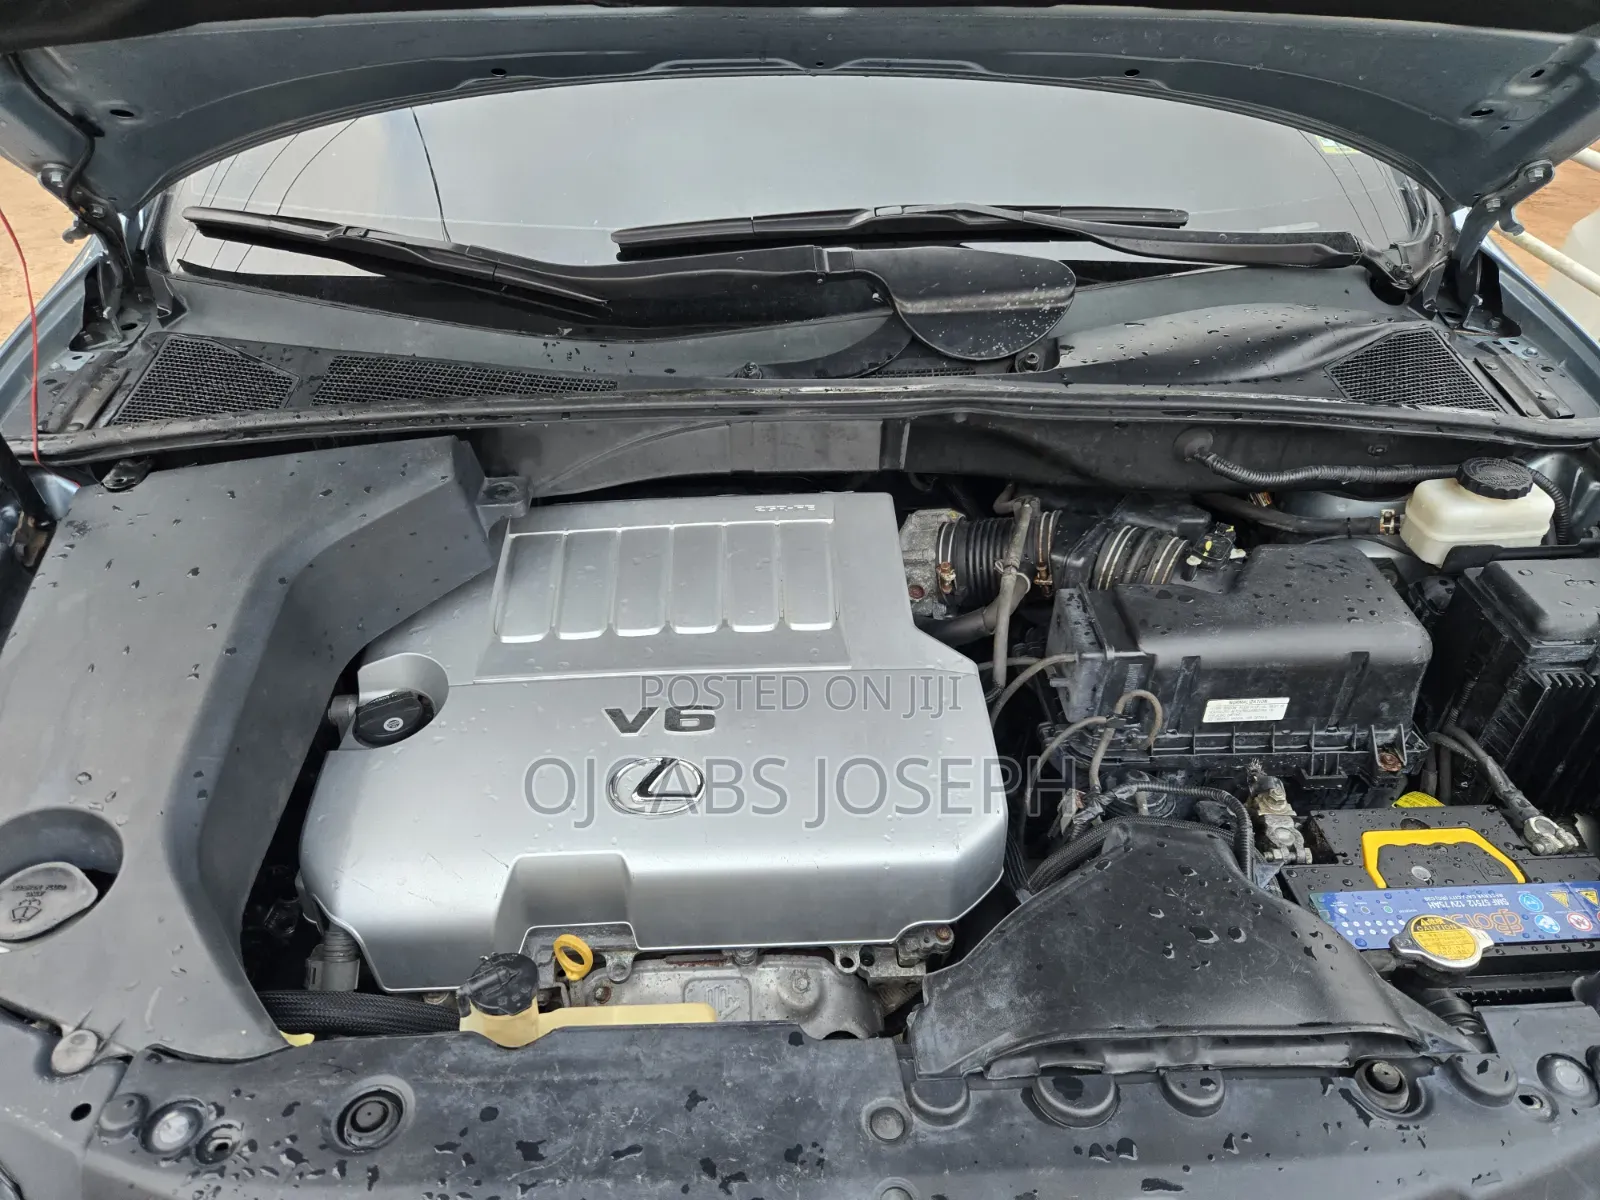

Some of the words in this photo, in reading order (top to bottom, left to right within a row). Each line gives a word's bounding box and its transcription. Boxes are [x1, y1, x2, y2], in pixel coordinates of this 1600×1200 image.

[602, 705, 716, 737] V6
[1427, 901, 1450, 909] 75AH
[1492, 897, 1510, 906] SMF
